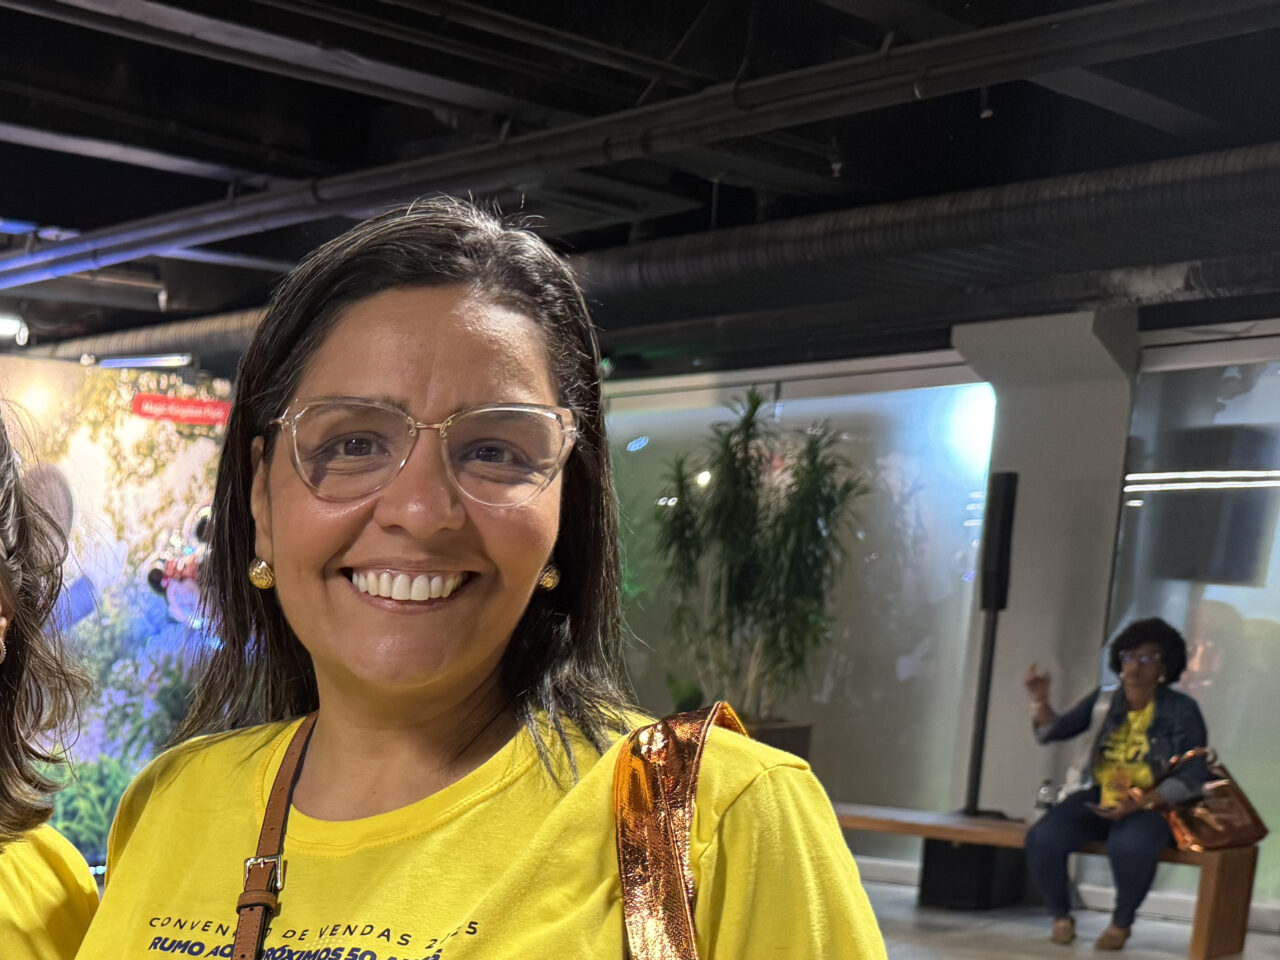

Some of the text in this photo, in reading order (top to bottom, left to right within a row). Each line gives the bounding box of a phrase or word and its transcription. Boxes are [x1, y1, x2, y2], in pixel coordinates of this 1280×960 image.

[282, 928, 309, 941] DE
[319, 924, 411, 946] VENDAS
[148, 936, 205, 956] RUMO
